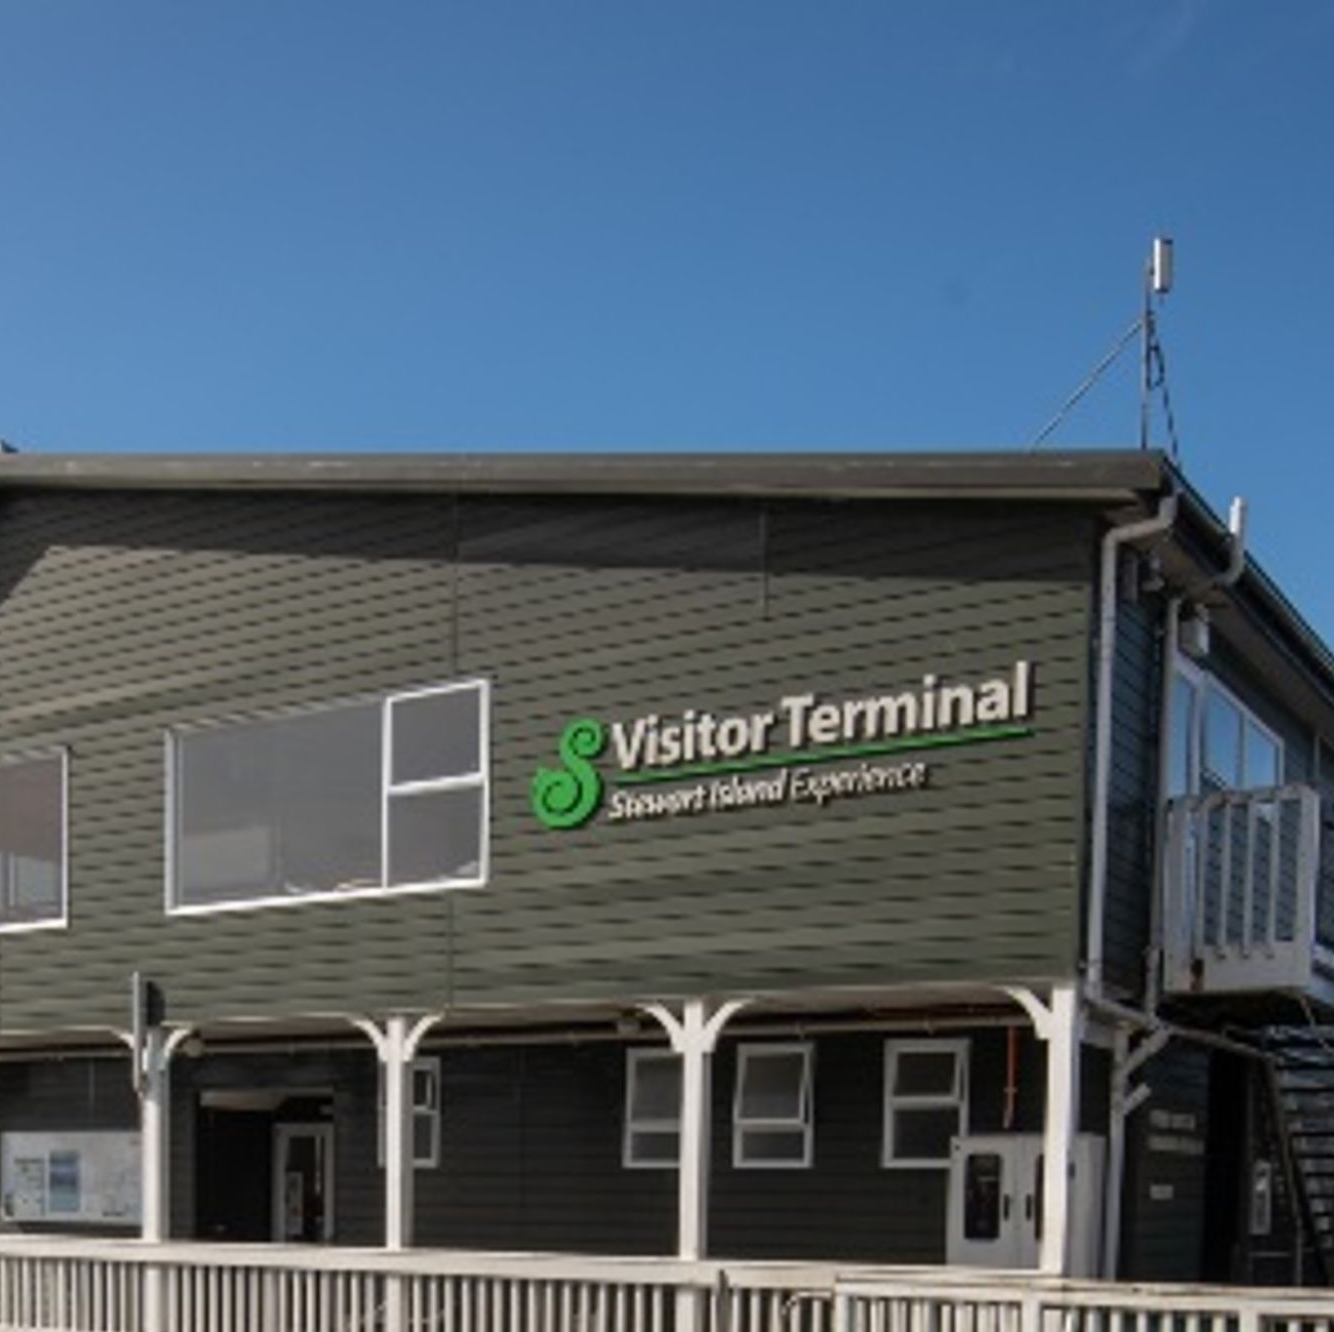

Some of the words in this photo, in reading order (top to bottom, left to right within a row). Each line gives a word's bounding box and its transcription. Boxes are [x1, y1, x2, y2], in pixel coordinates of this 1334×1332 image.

[610, 709, 774, 770] Visitor
[782, 660, 1030, 747] Terminal
[608, 783, 707, 819] Stewart
[710, 767, 788, 808] Island
[790, 763, 926, 806] Experience
